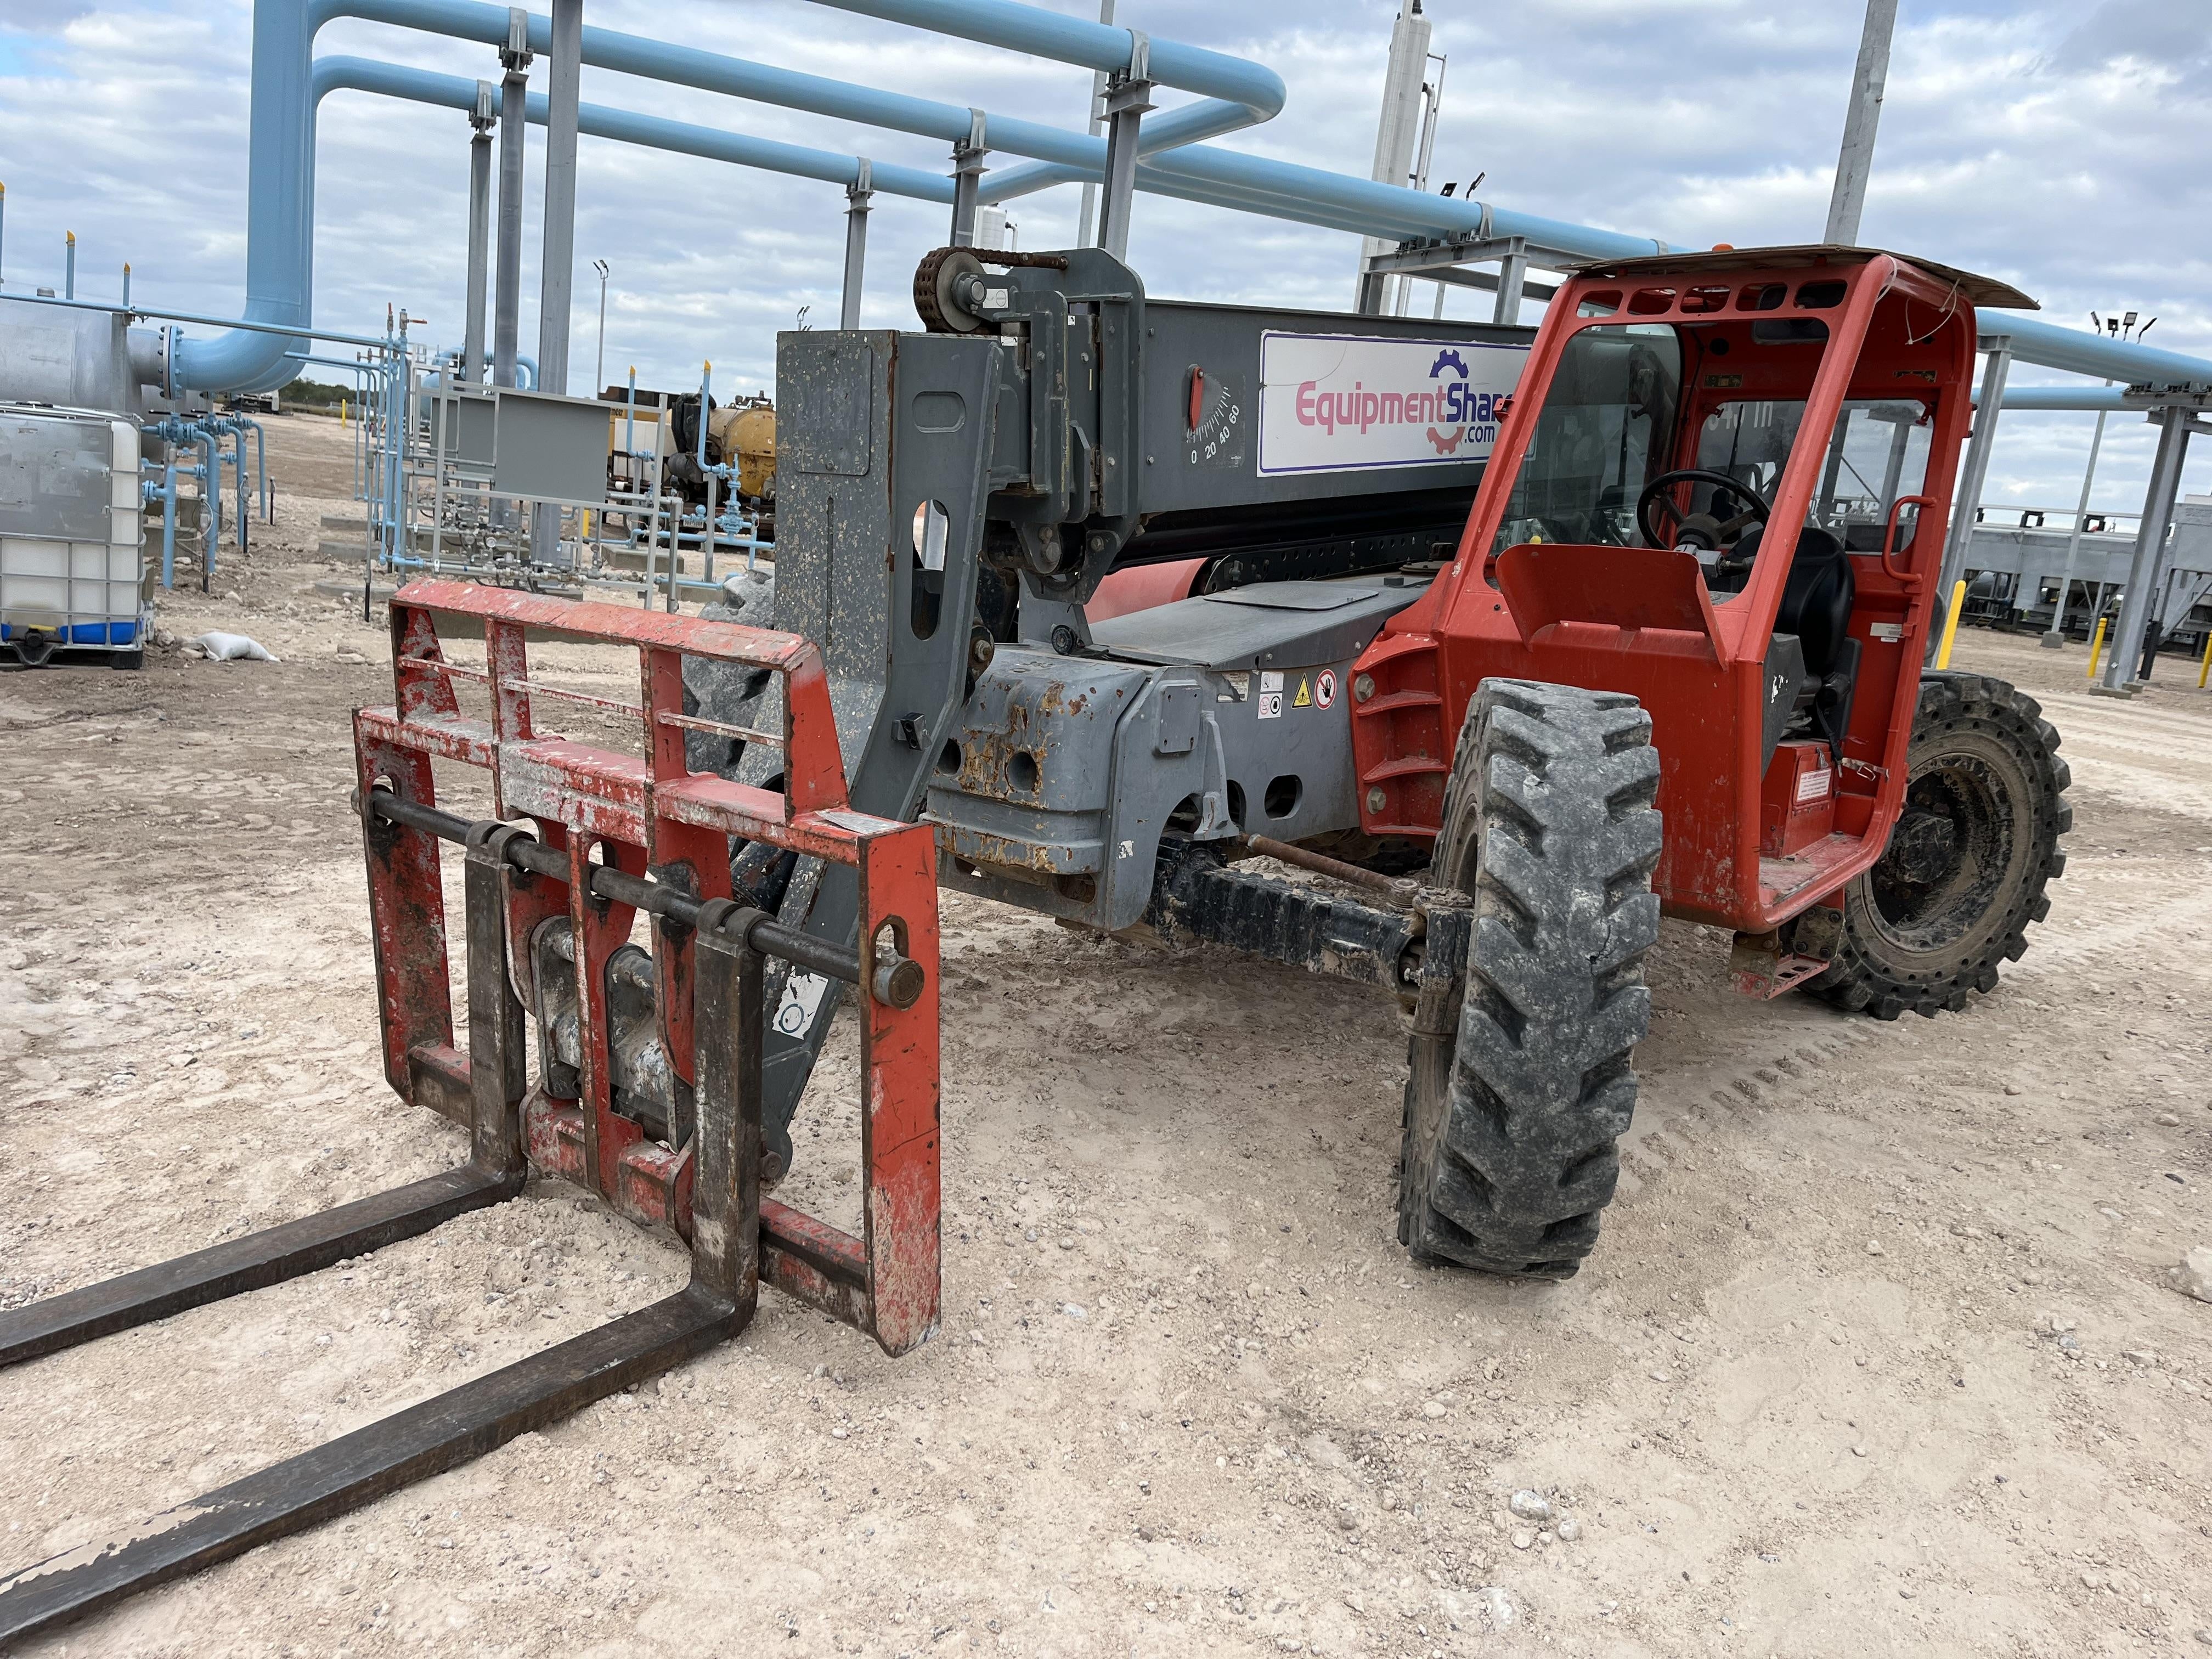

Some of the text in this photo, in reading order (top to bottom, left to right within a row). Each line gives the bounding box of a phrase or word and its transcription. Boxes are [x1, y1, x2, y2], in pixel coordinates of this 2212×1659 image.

[1191, 405, 1239, 464] 0 20 40 60
[1296, 381, 1513, 435] EquipmentShar
[1464, 426, 1495, 443] .com
